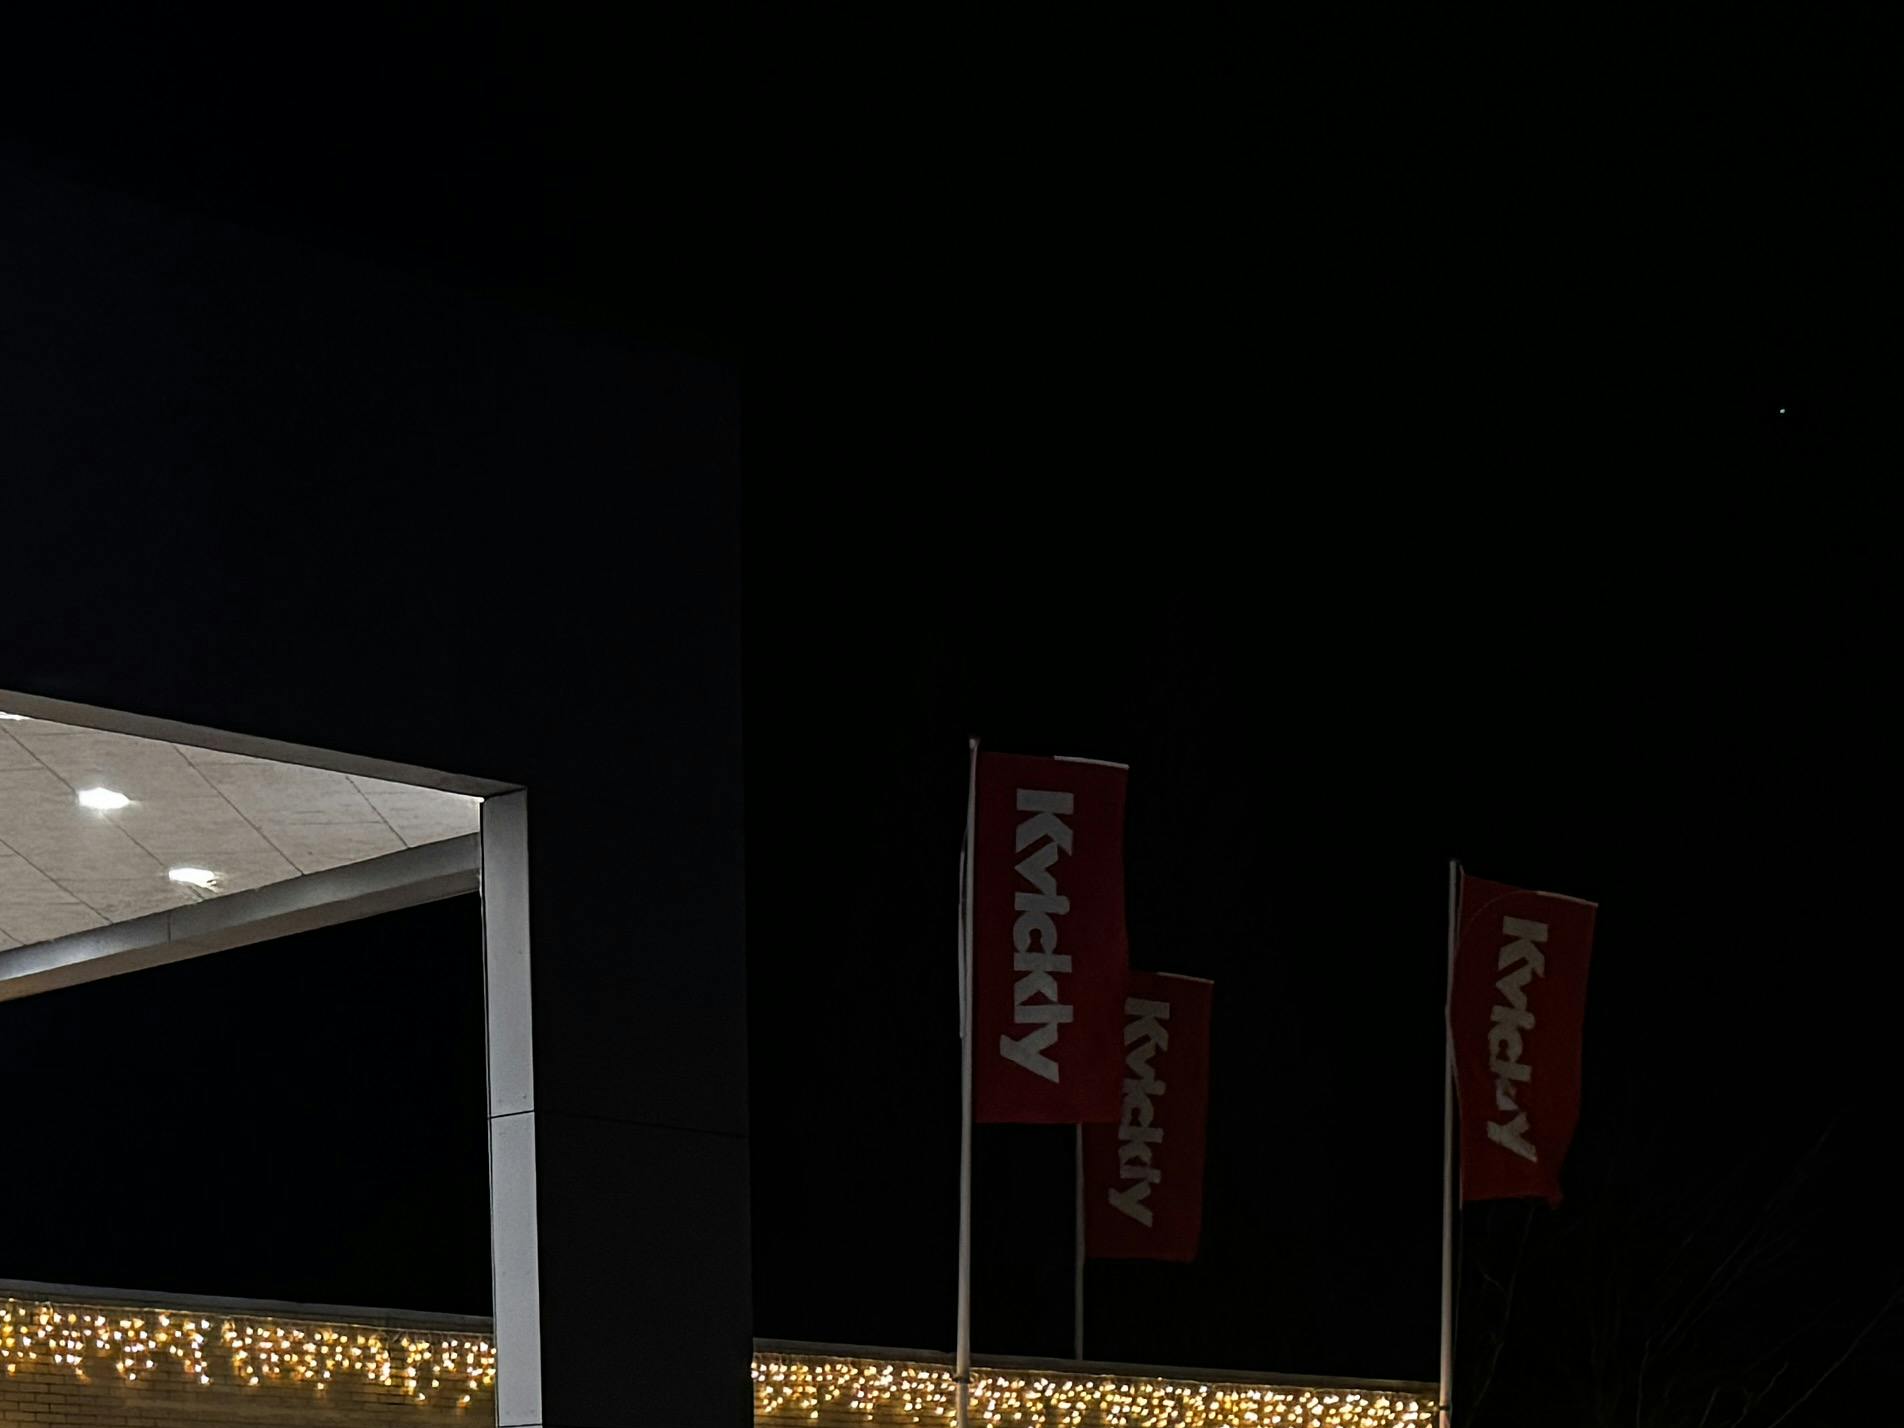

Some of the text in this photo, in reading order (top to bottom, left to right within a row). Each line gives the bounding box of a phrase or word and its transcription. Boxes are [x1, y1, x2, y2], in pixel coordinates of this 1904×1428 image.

[999, 788, 1075, 1084] Kvickly
[1485, 914, 1549, 1163] Kvickly
[1108, 996, 1171, 1228] Kvickly
